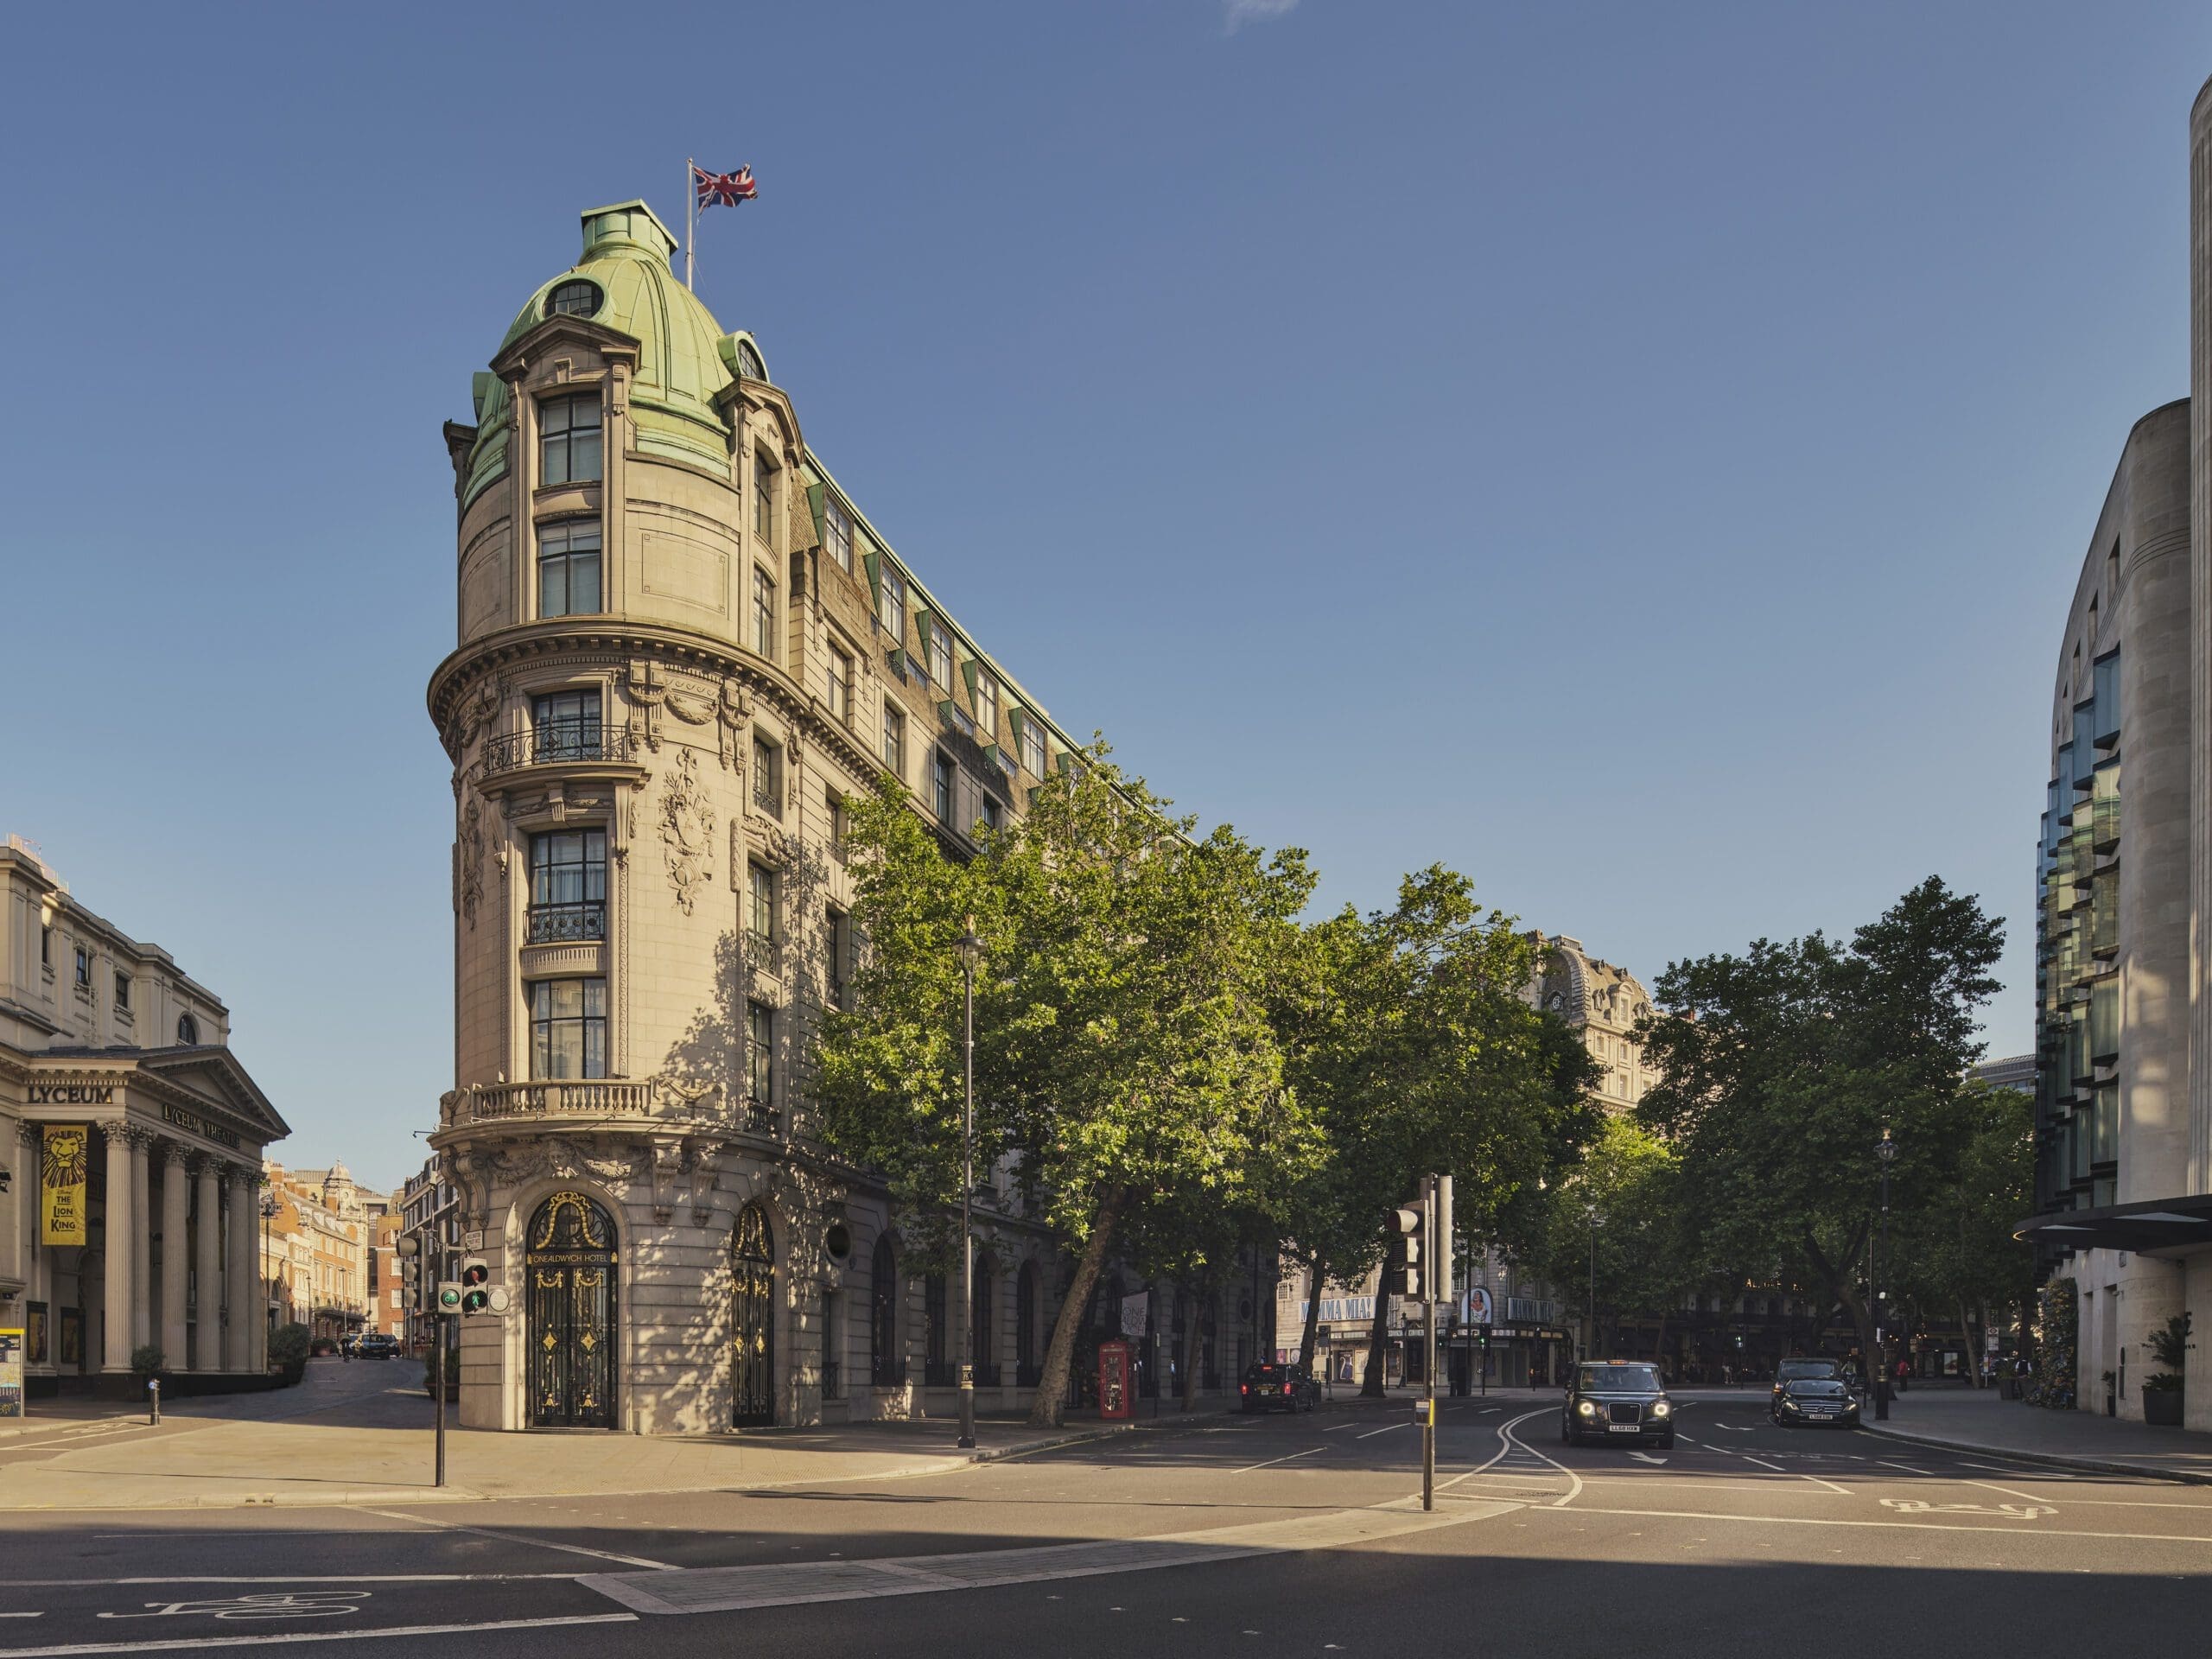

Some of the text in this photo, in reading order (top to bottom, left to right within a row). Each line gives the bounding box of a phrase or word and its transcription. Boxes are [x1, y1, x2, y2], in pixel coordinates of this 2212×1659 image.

[28, 1086, 113, 1104] LYCEUM
[162, 1104, 242, 1149] LYCEUM THEATRE
[54, 1205, 73, 1217] LION
[51, 1219, 76, 1232] KING
[584, 1254, 607, 1262] HOTEL
[1122, 1306, 1146, 1317] ONE
[1300, 1298, 1371, 1321] MMMA MIA!
